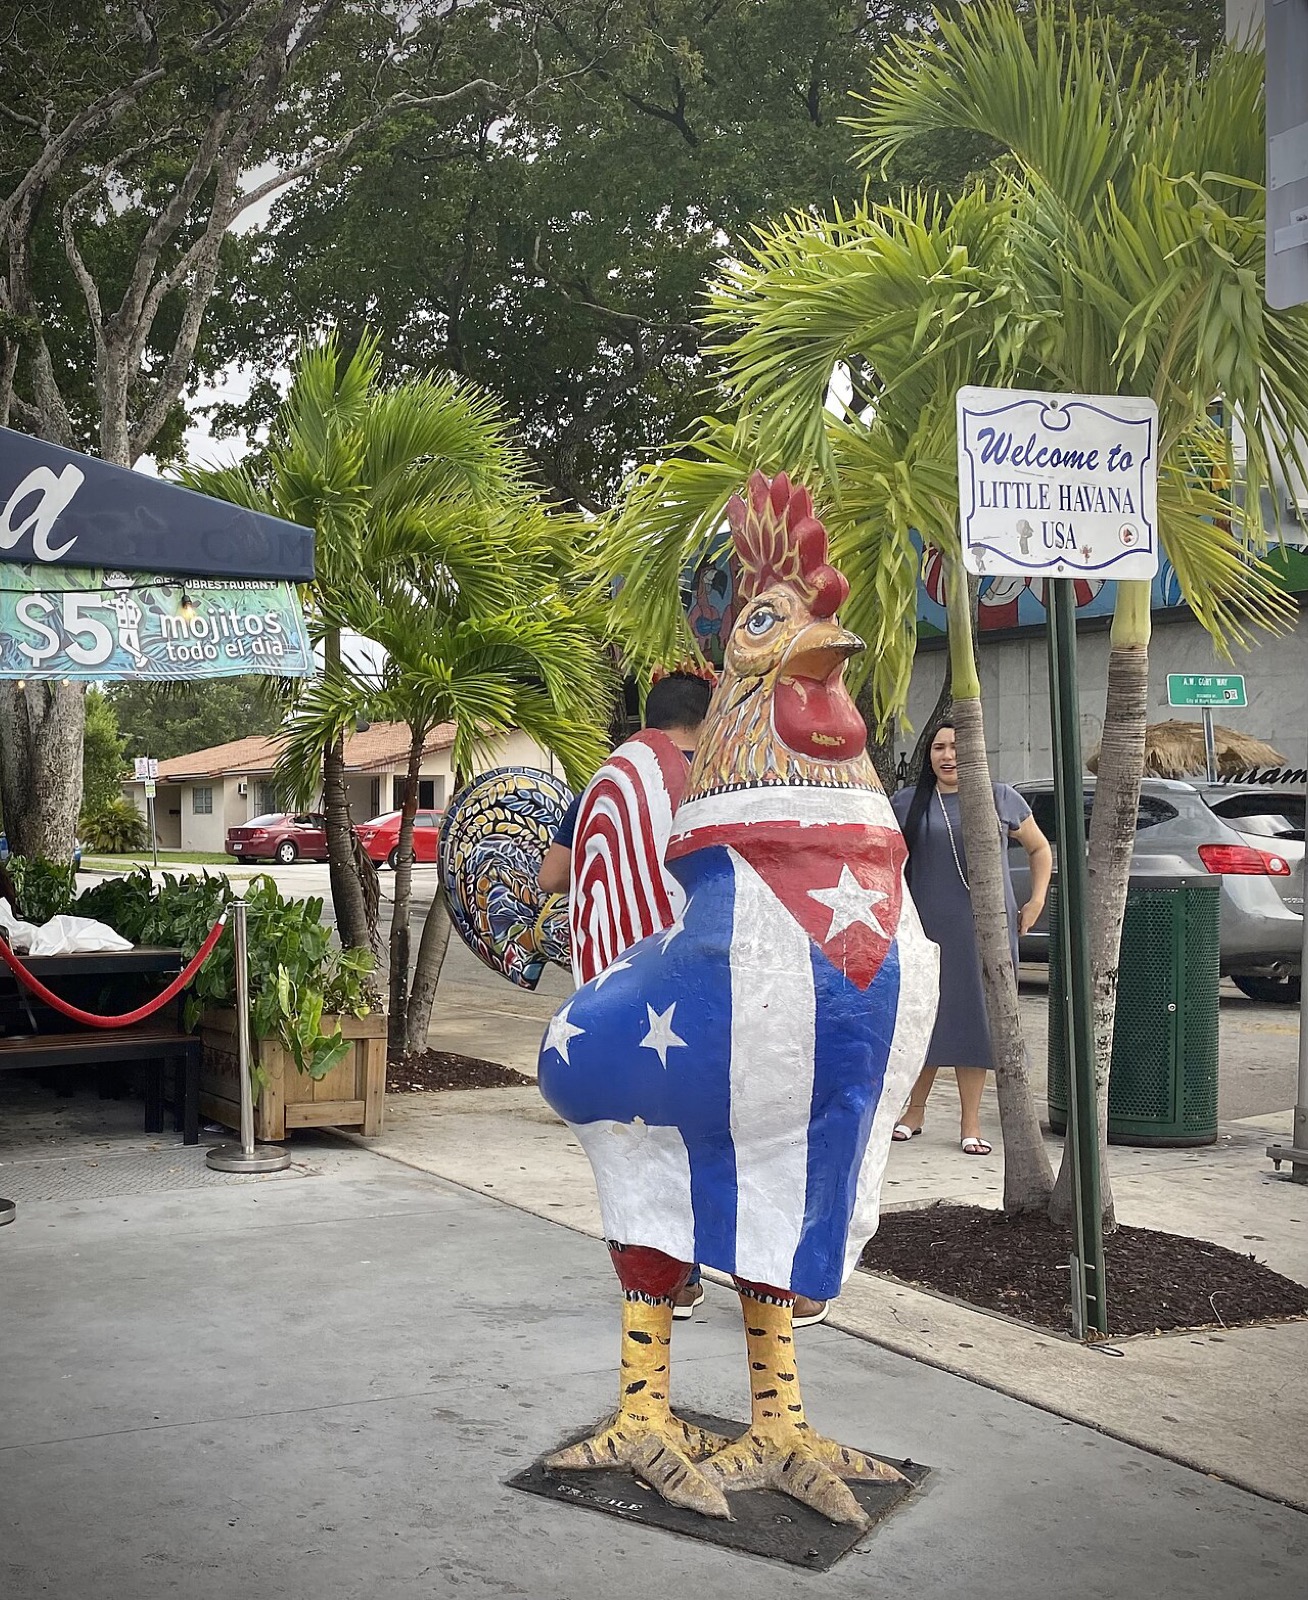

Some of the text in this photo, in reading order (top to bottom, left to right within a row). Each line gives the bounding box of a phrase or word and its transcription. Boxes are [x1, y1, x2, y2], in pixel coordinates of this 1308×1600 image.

[977, 427, 1134, 472] Welcome to
[978, 480, 1136, 514] LITTLE HAVANA
[1041, 520, 1078, 549] USA
[15, 588, 113, 668] $5
[159, 607, 282, 644] mojitos
[166, 639, 218, 661] todo
[225, 639, 245, 658] el
